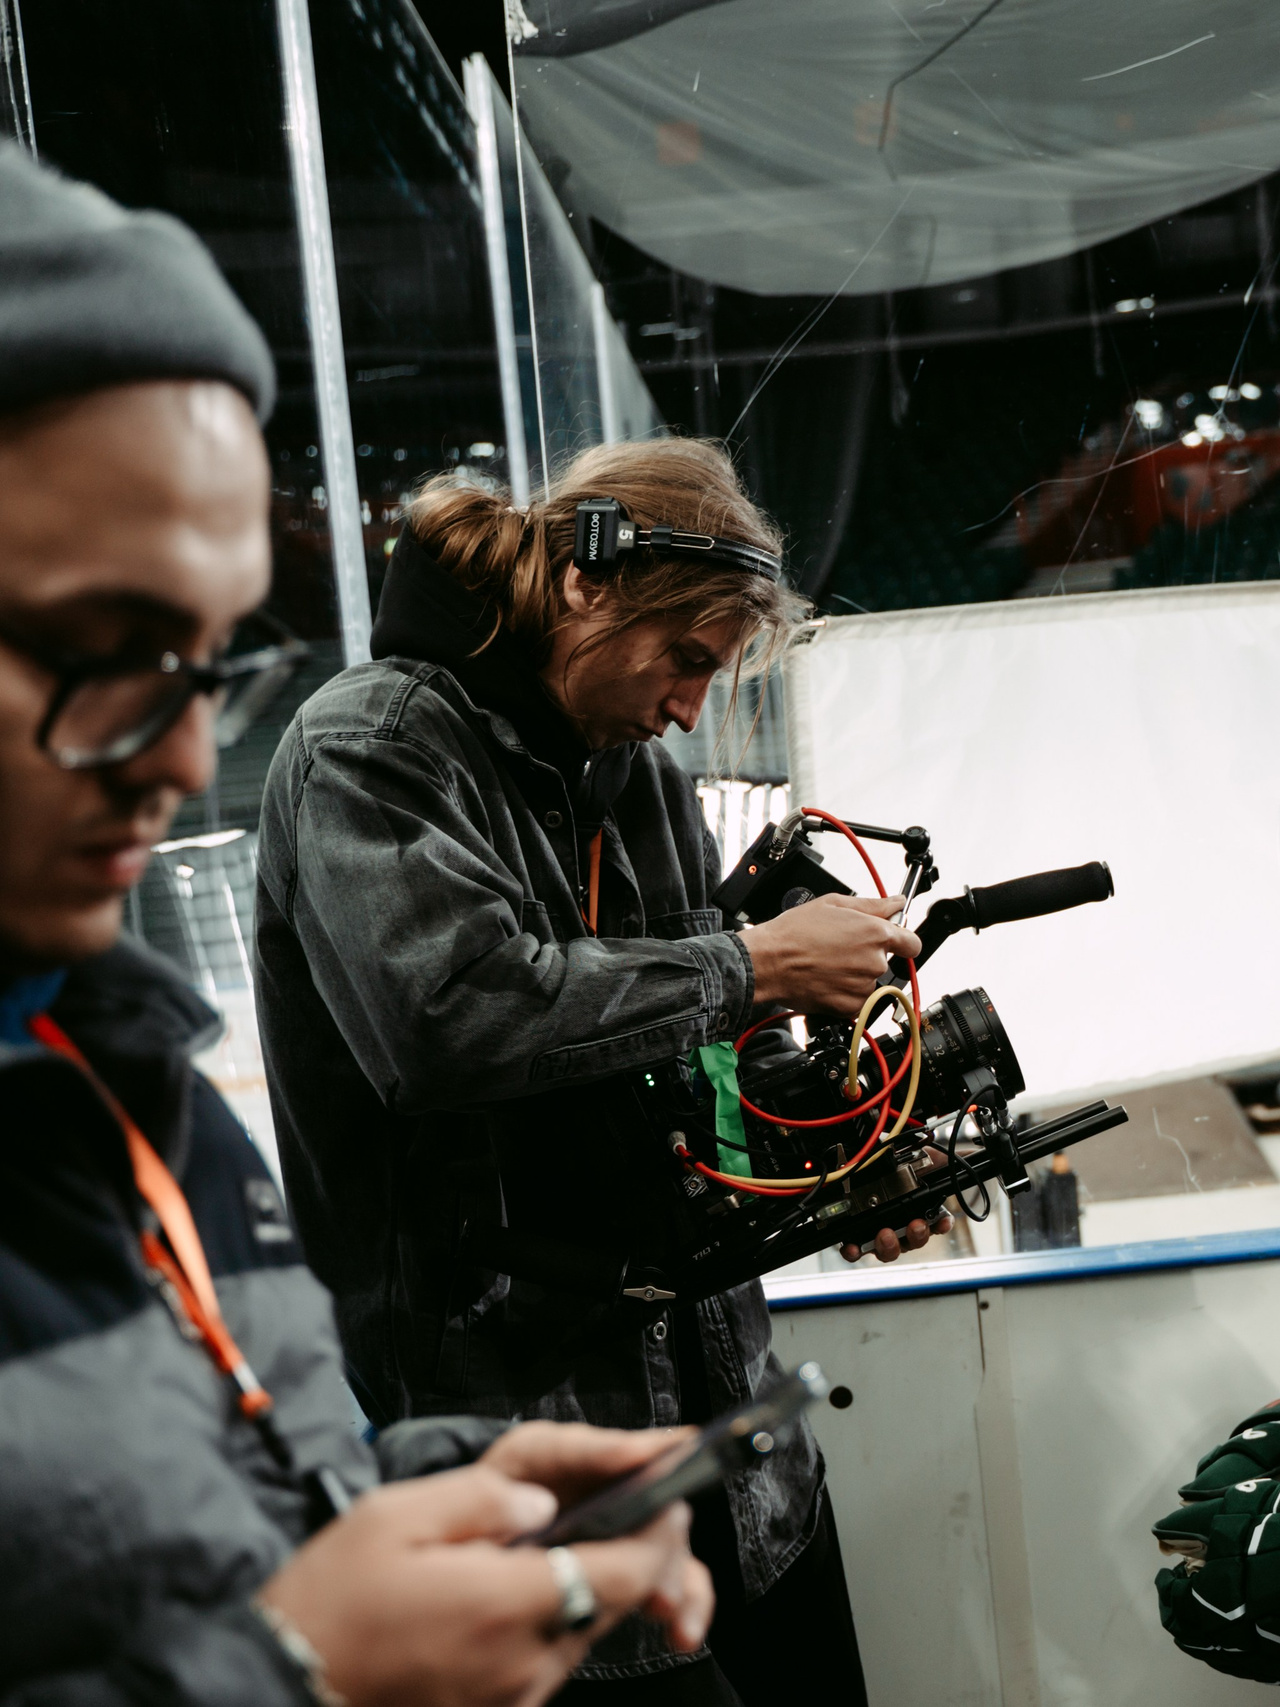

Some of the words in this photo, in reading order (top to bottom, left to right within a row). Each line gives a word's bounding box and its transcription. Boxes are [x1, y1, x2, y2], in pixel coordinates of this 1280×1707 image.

[588, 513, 600, 560] ФОТОЗУМ
[618, 528, 634, 540] 5
[933, 1044, 946, 1057] 32
